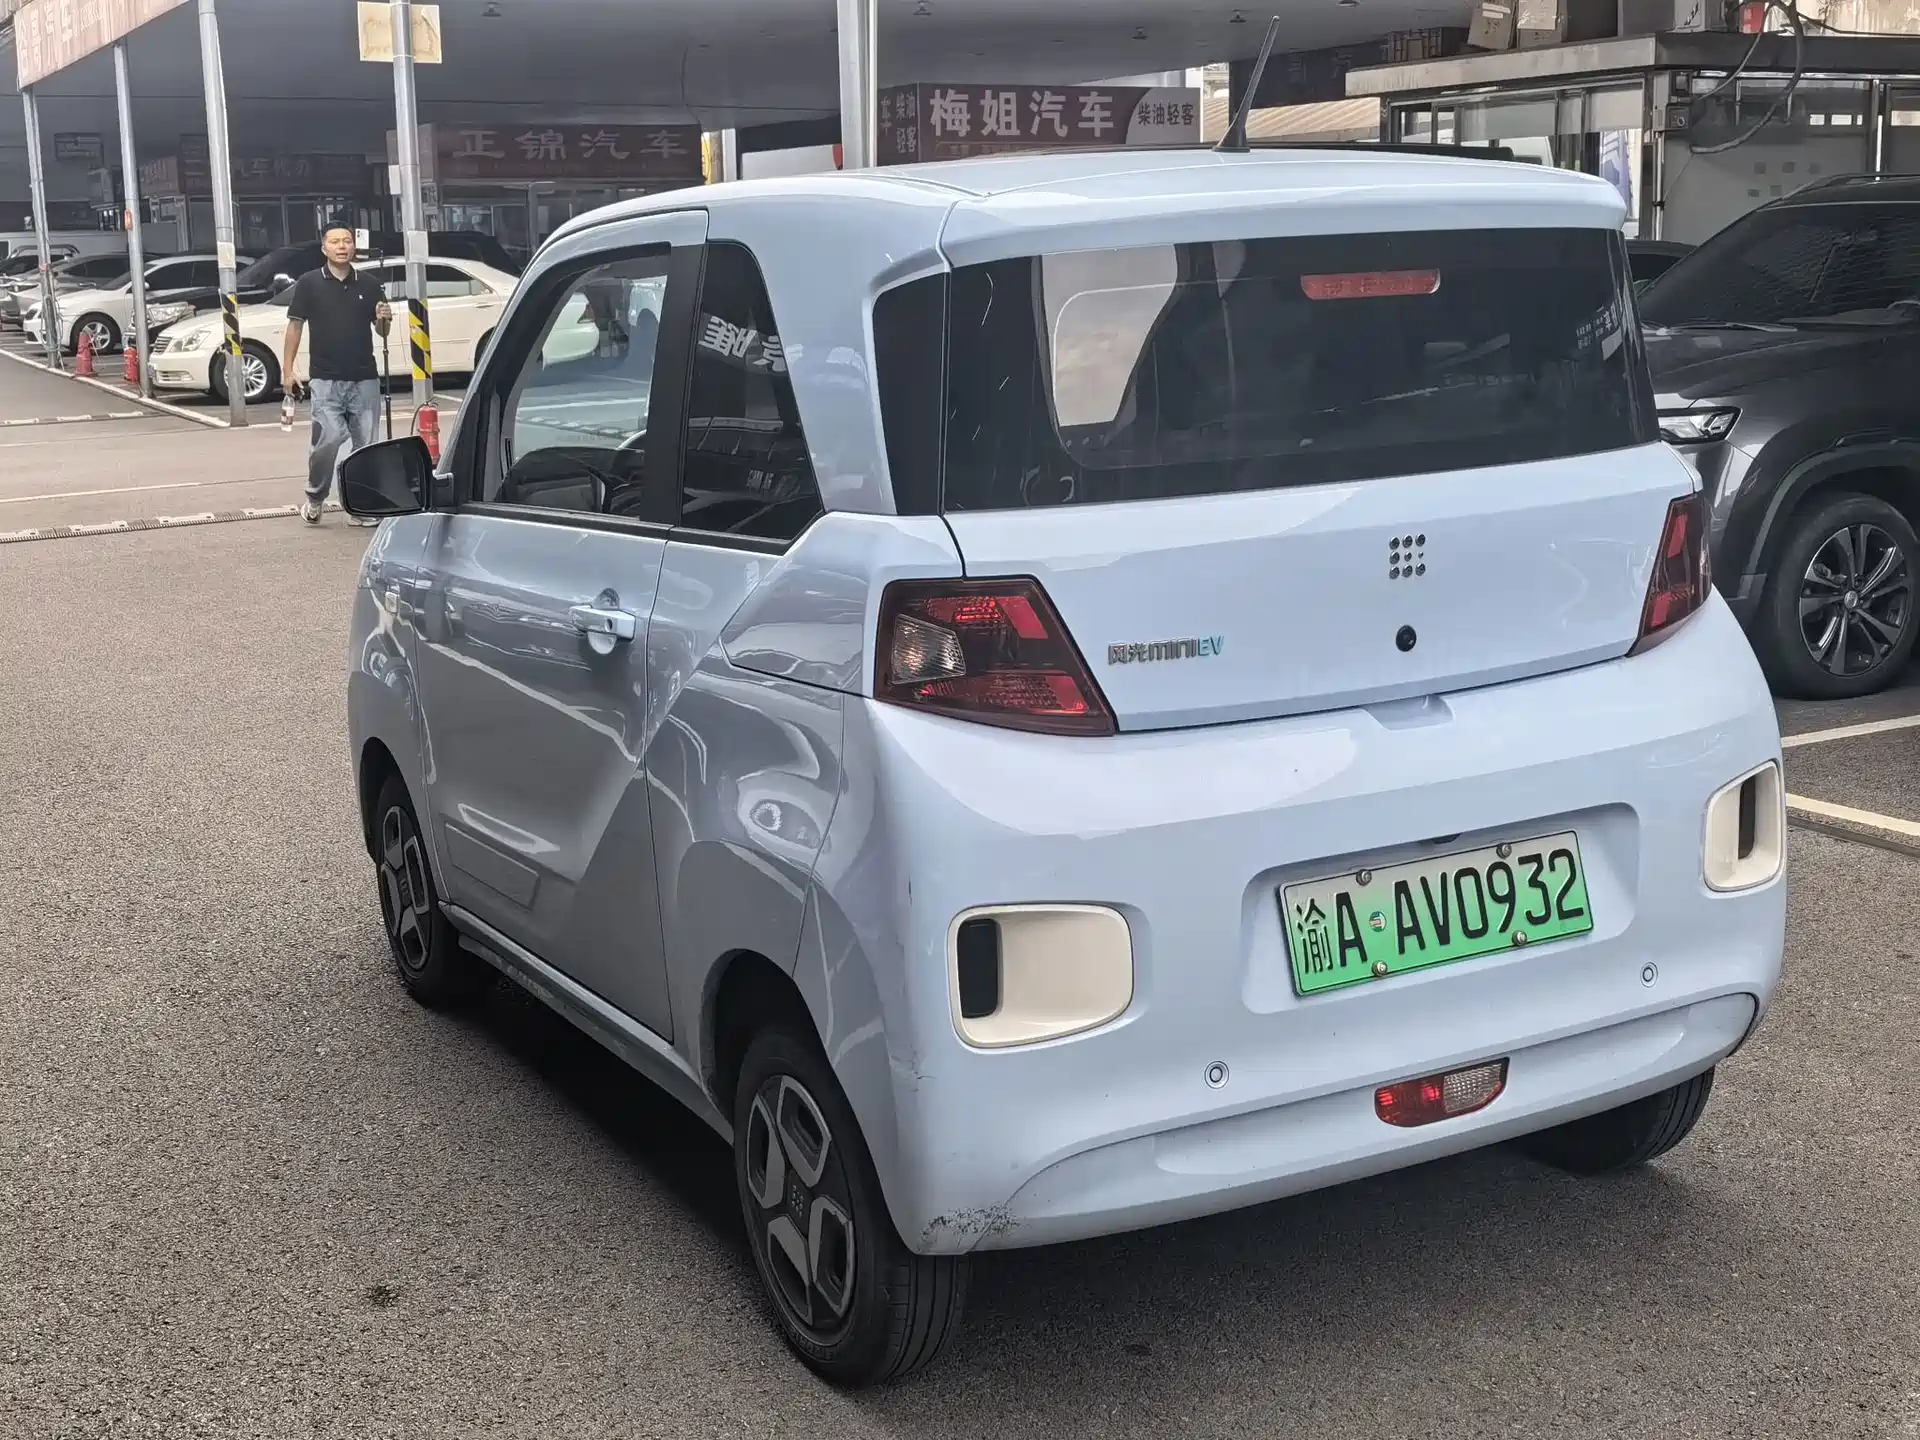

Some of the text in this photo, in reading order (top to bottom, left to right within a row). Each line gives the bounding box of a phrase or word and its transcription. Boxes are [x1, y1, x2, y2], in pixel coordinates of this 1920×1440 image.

[930, 89, 1115, 137] 梅姐汽车
[1137, 101, 1195, 125] 柴油轻客
[453, 129, 688, 161] 正锦汽车
